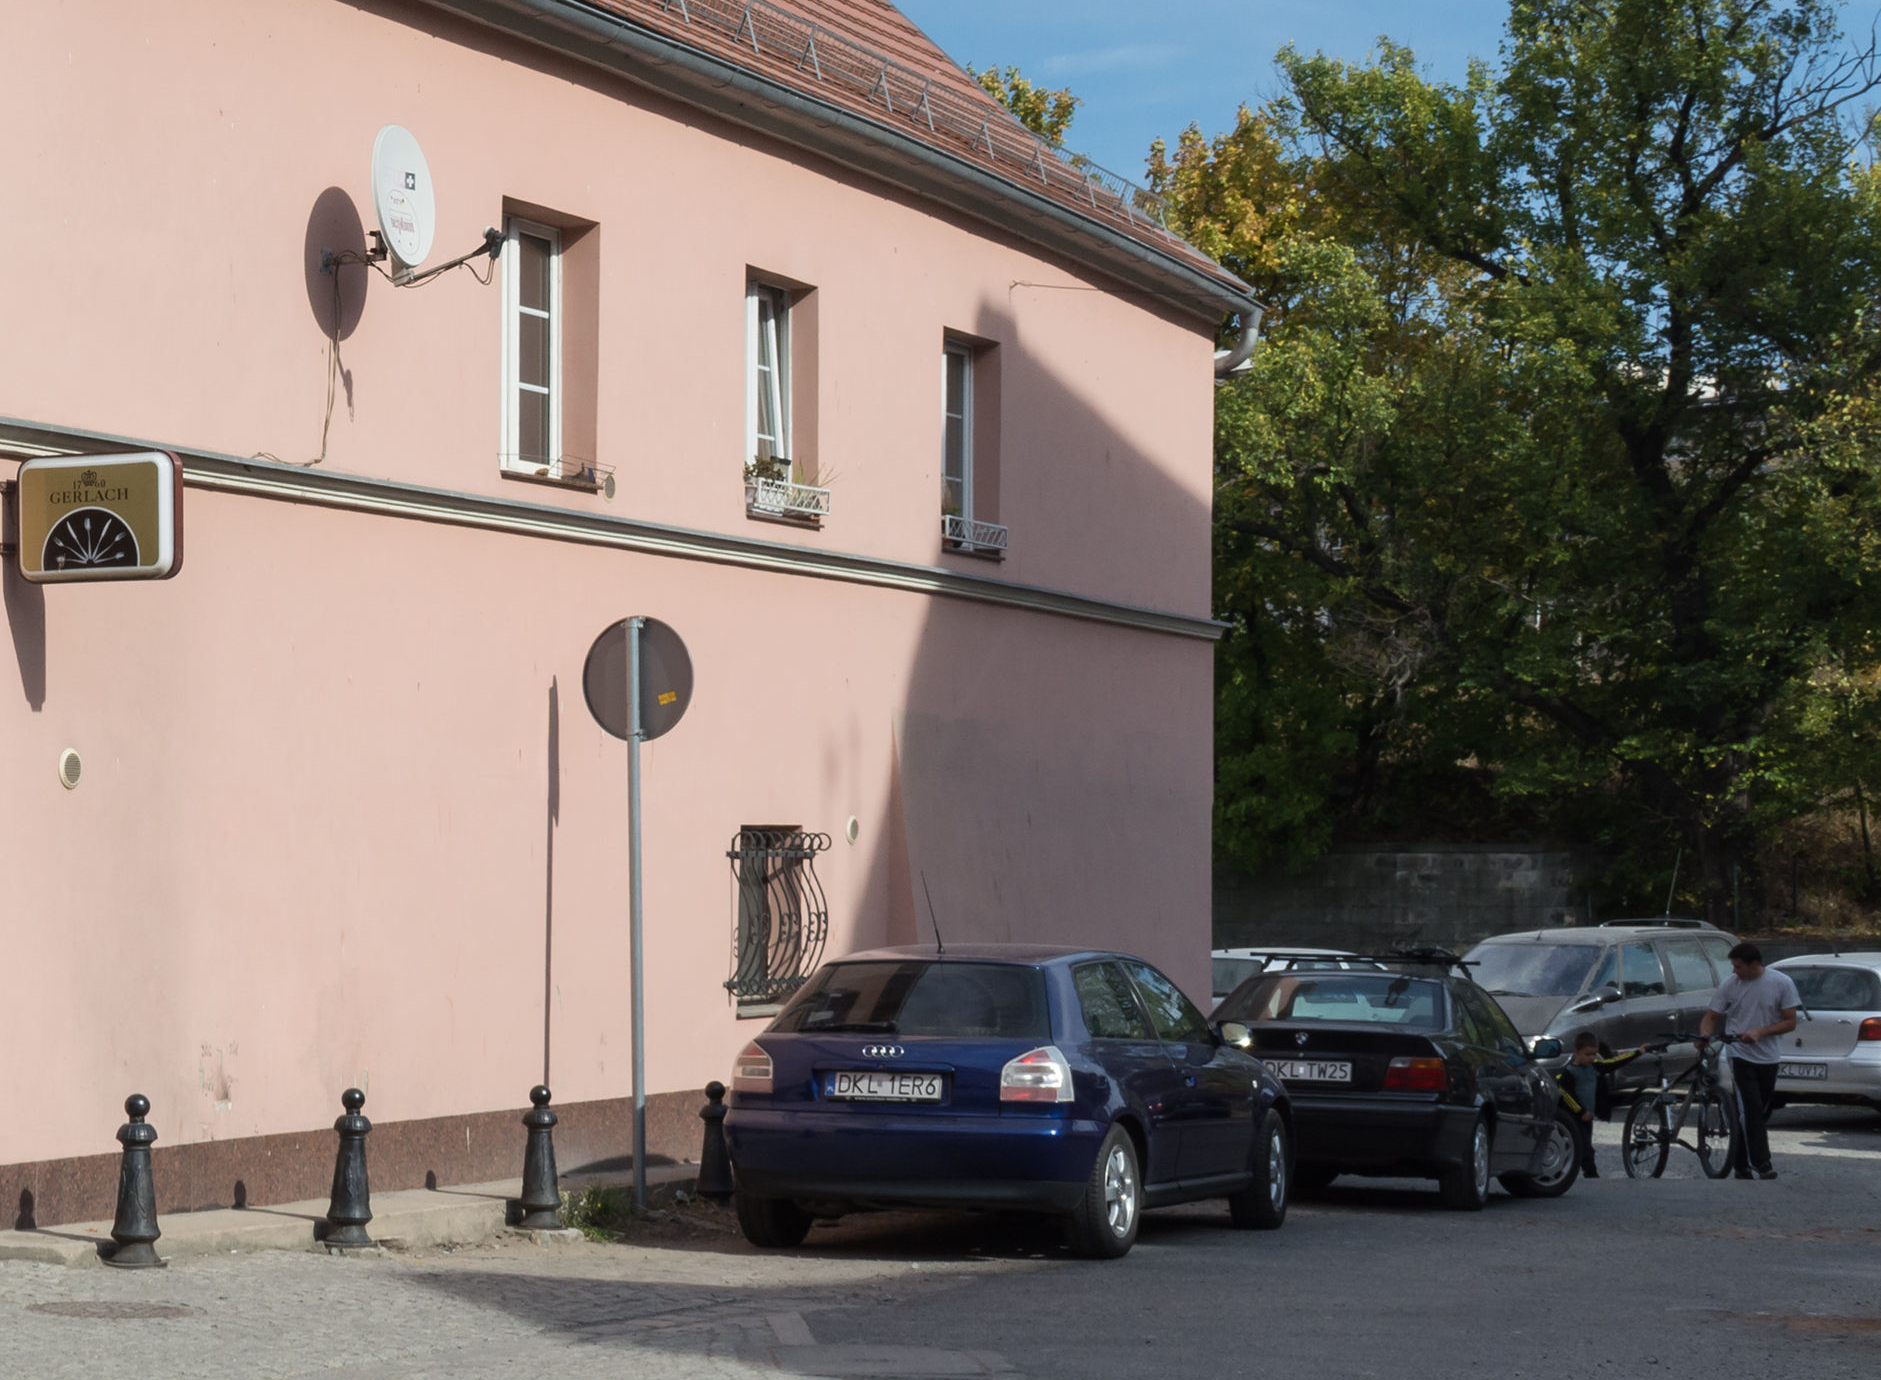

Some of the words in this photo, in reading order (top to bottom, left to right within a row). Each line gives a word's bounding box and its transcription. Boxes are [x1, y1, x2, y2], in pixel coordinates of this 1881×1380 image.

[49, 487, 129, 505] GERLACH
[1265, 1061, 1299, 1078] DKL
[1306, 1062, 1348, 1079] TW25
[838, 1074, 878, 1094] DKL
[889, 1075, 937, 1096] 1ER6
